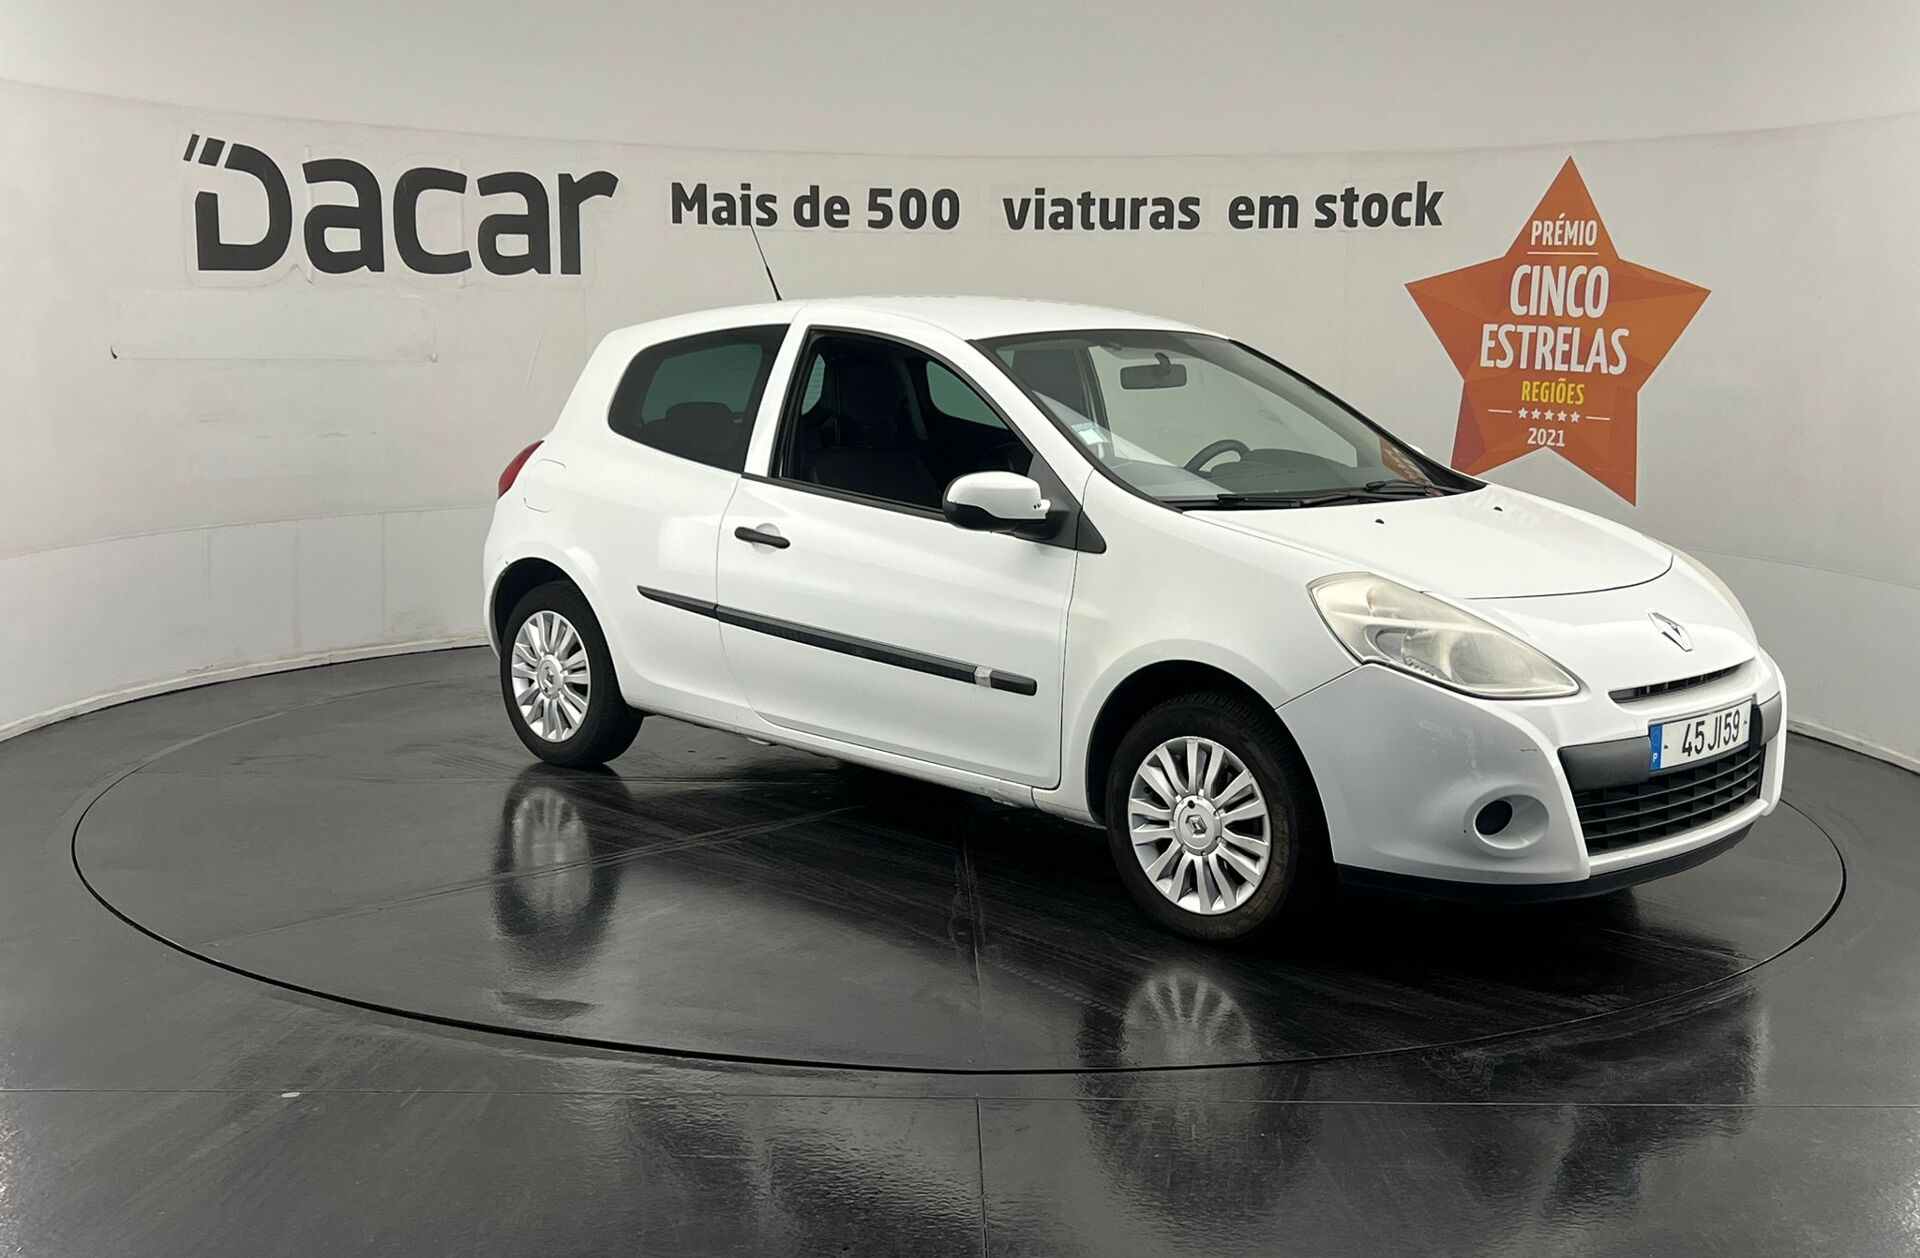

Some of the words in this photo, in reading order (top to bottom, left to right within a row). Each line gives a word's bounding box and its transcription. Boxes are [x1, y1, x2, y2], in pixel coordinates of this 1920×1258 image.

[184, 134, 619, 276] Dacar
[671, 181, 778, 228] Mais
[793, 184, 851, 230] de
[867, 187, 960, 231] 500
[1003, 187, 1201, 231] viaturas
[1228, 195, 1299, 230] em
[1314, 180, 1445, 229] stock
[1530, 213, 1598, 247] PRÉMIO
[1510, 264, 1610, 319] CINCO
[1479, 323, 1630, 376] ESTRELAS
[1521, 377, 1585, 406] REGIÕES
[1527, 427, 1566, 447] 2021
